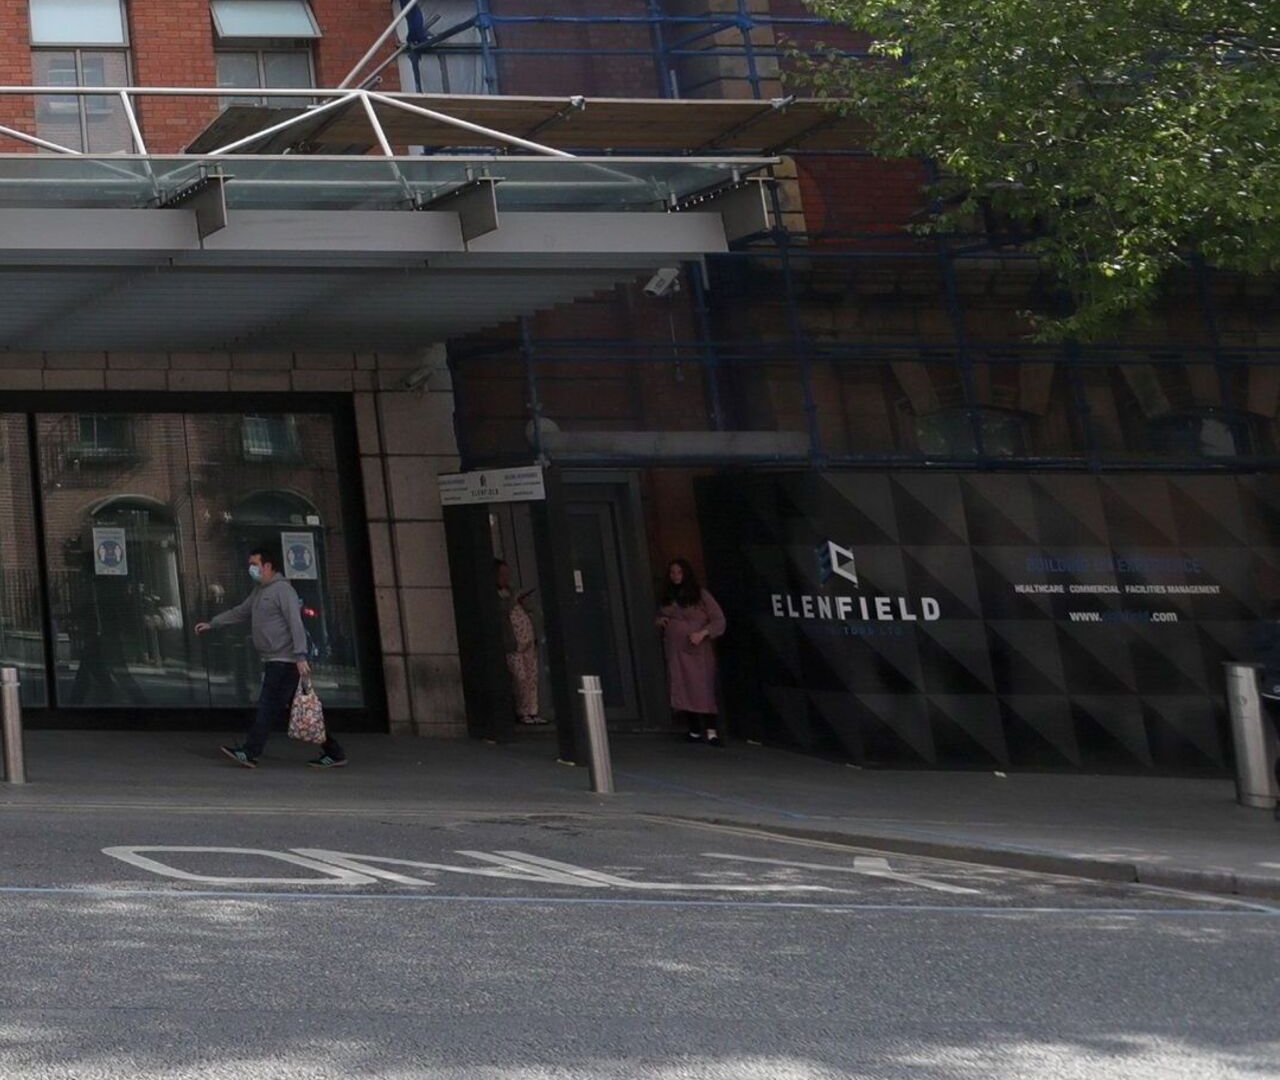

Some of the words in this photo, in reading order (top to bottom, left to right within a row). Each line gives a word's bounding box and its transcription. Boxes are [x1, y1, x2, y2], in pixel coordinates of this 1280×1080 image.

[1014, 584, 1065, 594] HEALTHCARE
[1069, 584, 1120, 594] COMMERCIAL
[1125, 585, 1166, 594] FACILITIES
[1167, 585, 1220, 594] MANAGEMENT
[771, 593, 941, 622] ELENFIELD
[98, 843, 982, 895] ONLY
